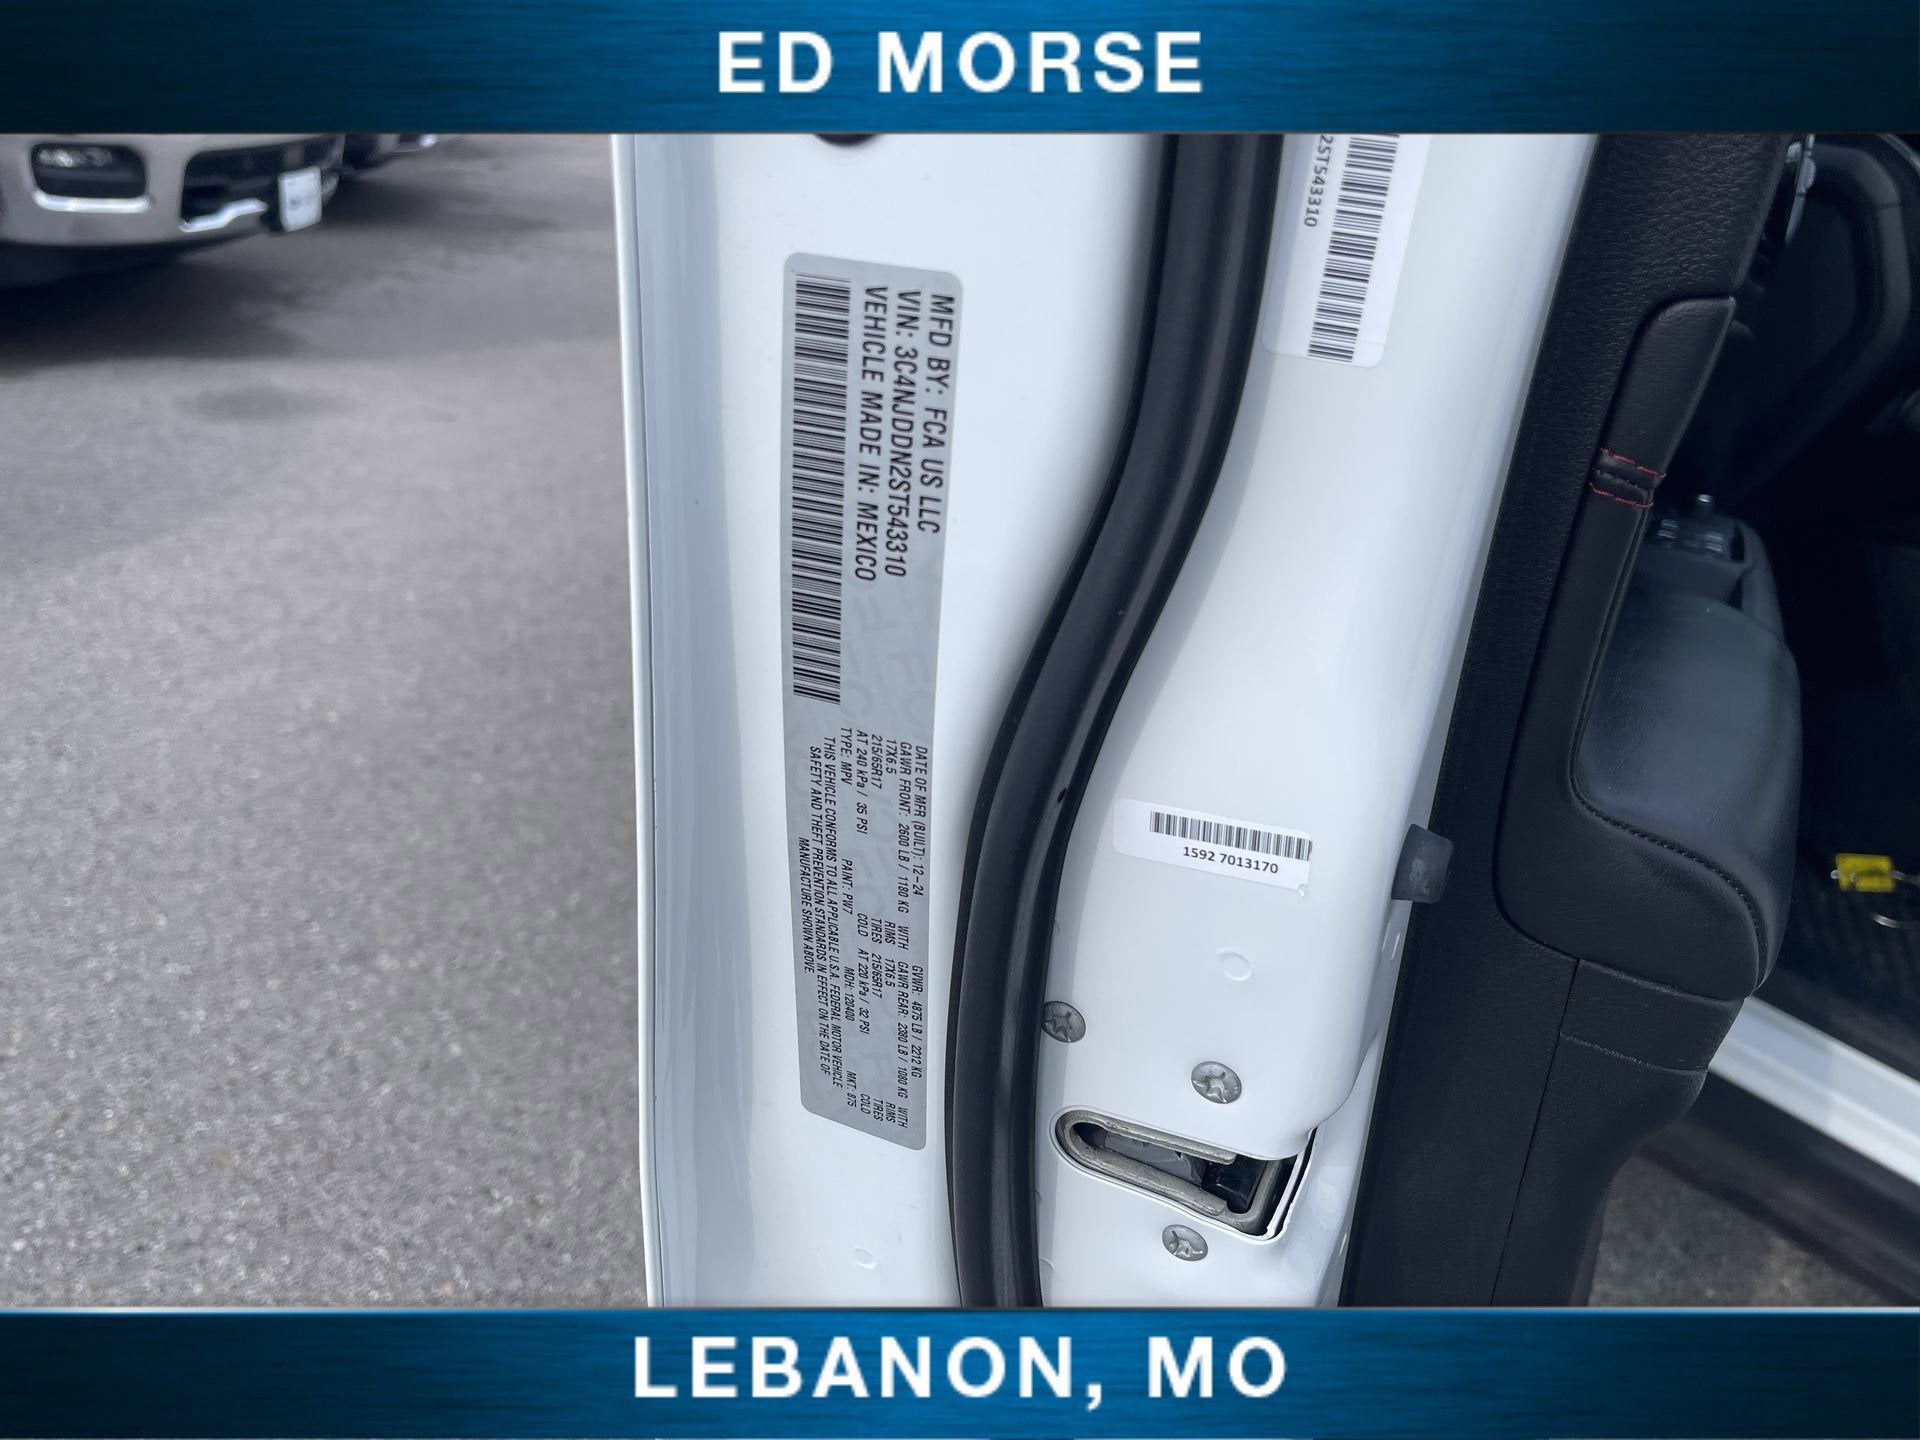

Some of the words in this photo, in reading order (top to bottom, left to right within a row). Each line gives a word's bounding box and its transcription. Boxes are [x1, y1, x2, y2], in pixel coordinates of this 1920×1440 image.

[896, 291, 920, 337] VIN:
[930, 295, 954, 346] MFD
[862, 287, 887, 382] VEHICLE
[925, 358, 950, 394] BY:
[860, 391, 882, 455] MADE
[923, 408, 947, 448] FCA
[885, 346, 917, 577] 3C4NJDDN2ST543310
[858, 464, 880, 492] IN:
[920, 459, 943, 488] US
[918, 496, 940, 533] LLC
[855, 502, 878, 581] MEXICO
[824, 737, 836, 760] THIS
[857, 730, 868, 745] AT
[810, 746, 822, 786] SAFETY
[900, 742, 911, 775] GAWR
[915, 746, 927, 775] DATE
[841, 761, 852, 785] MPV
[857, 770, 867, 788] kPa
[915, 778, 927, 791] OF
[825, 765, 836, 806] VEHICLE
[811, 788, 822, 810] AND
[914, 795, 926, 817] MFR
[812, 814, 822, 845] THEFT
[825, 808, 836, 862] CONFORMS
[857, 817, 867, 834] PSI
[898, 850, 908, 861] LB
[1219, 853, 1279, 874] 7013170
[799, 837, 811, 906] MANUFACTURE
[812, 847, 824, 908] PREVENTION
[826, 865, 837, 876] TO
[827, 880, 837, 896] ALL
[898, 900, 908, 913] KG
[802, 909, 814, 942] SHOWN
[814, 907, 826, 961] STANDARDS
[827, 899, 839, 953] APPLICABLE
[857, 913, 868, 936] COLD
[872, 918, 882, 944] TIRES
[884, 921, 895, 944] RIMS
[898, 925, 909, 949] WITH
[858, 948, 868, 962] AT
[816, 963, 827, 972] IN
[898, 961, 908, 989] GAWR
[817, 974, 828, 1005] EFFECT
[858, 981, 868, 995] kPa
[818, 1008, 828, 1019] ON
[830, 984, 841, 1021] FEDERAL
[819, 1022, 828, 1038] THE
[831, 1024, 841, 1052] MOTOR
[859, 1020, 868, 1034] PSI
[912, 1023, 922, 1034] LB
[820, 1040, 829, 1061] DATE
[898, 1044, 908, 1055] LB
[820, 1063, 830, 1075] OF
[832, 1054, 842, 1088] VEHICLE
[911, 1066, 921, 1078] KG
[860, 1094, 870, 1114] COLD
[898, 1087, 907, 1098] KG
[873, 1098, 883, 1121] TIRES
[886, 1102, 895, 1122] RIMS
[898, 1107, 907, 1128] WITH
